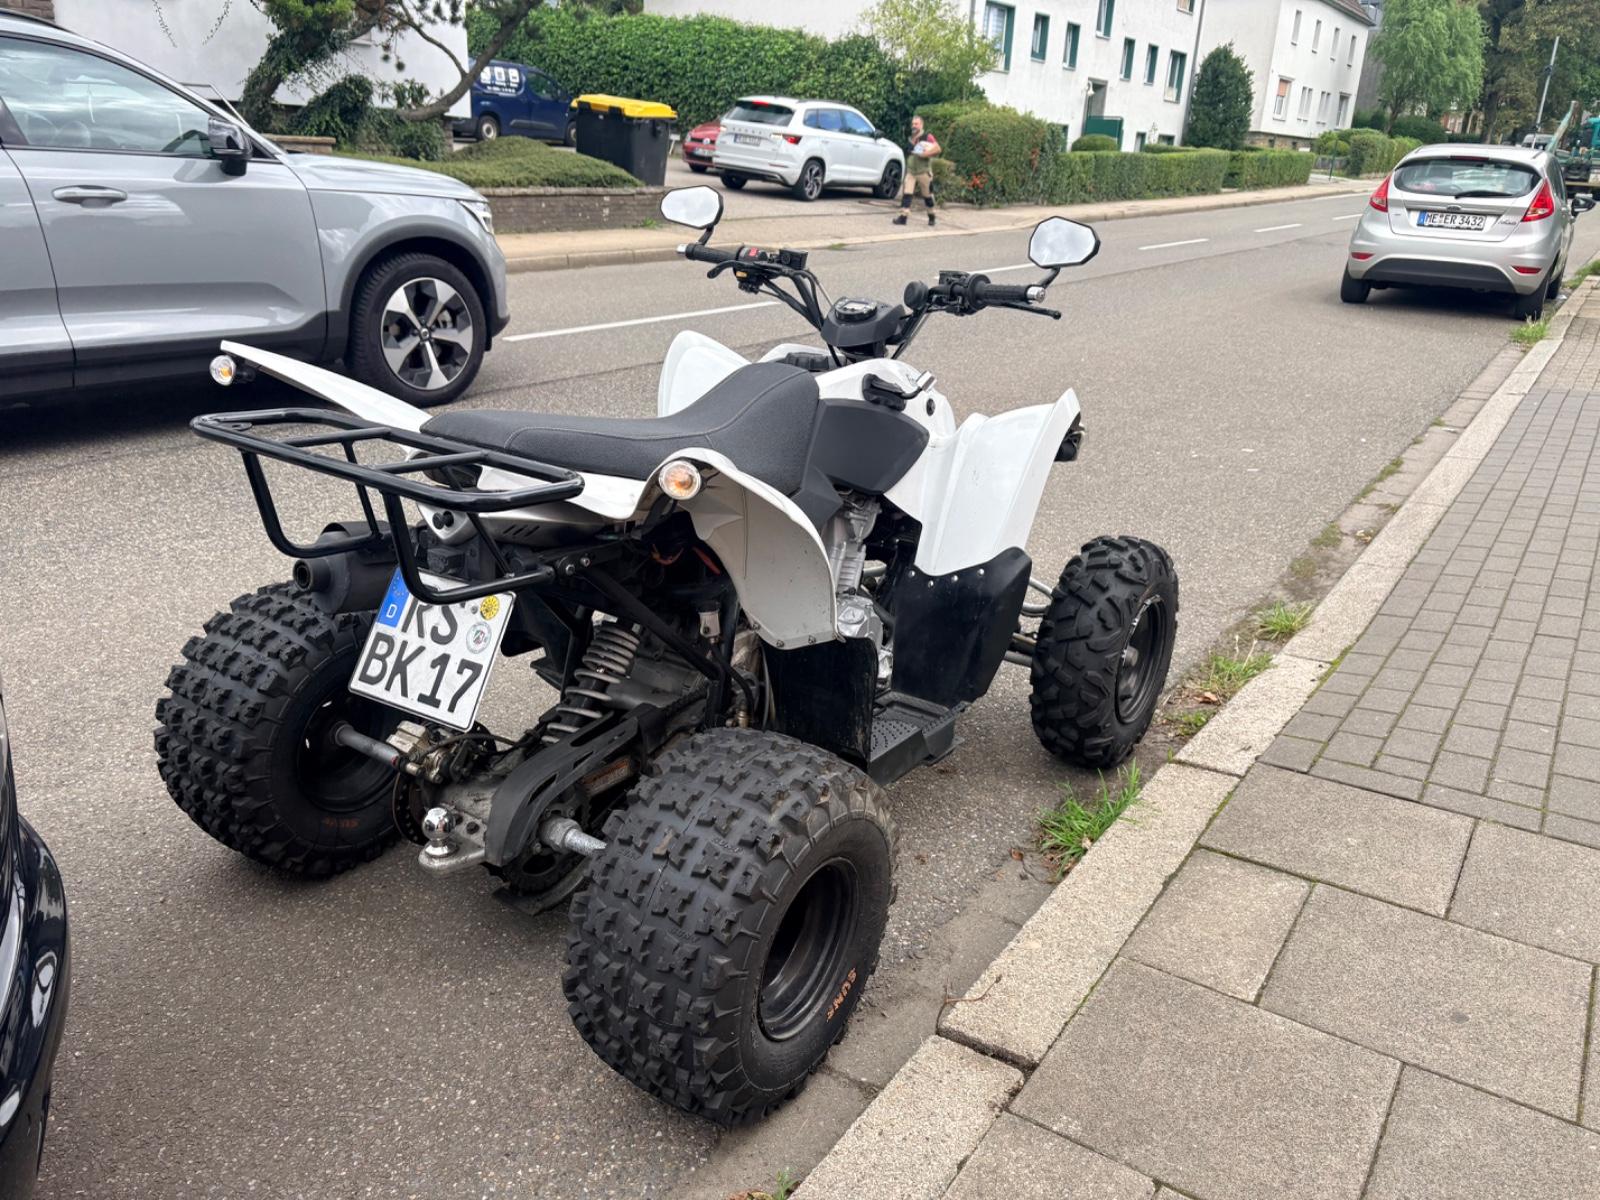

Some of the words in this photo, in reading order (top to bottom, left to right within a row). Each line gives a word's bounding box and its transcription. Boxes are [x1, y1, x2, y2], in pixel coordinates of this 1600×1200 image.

[1443, 213, 1457, 225] ER
[1458, 214, 1484, 227] 3432
[386, 604, 397, 618] D
